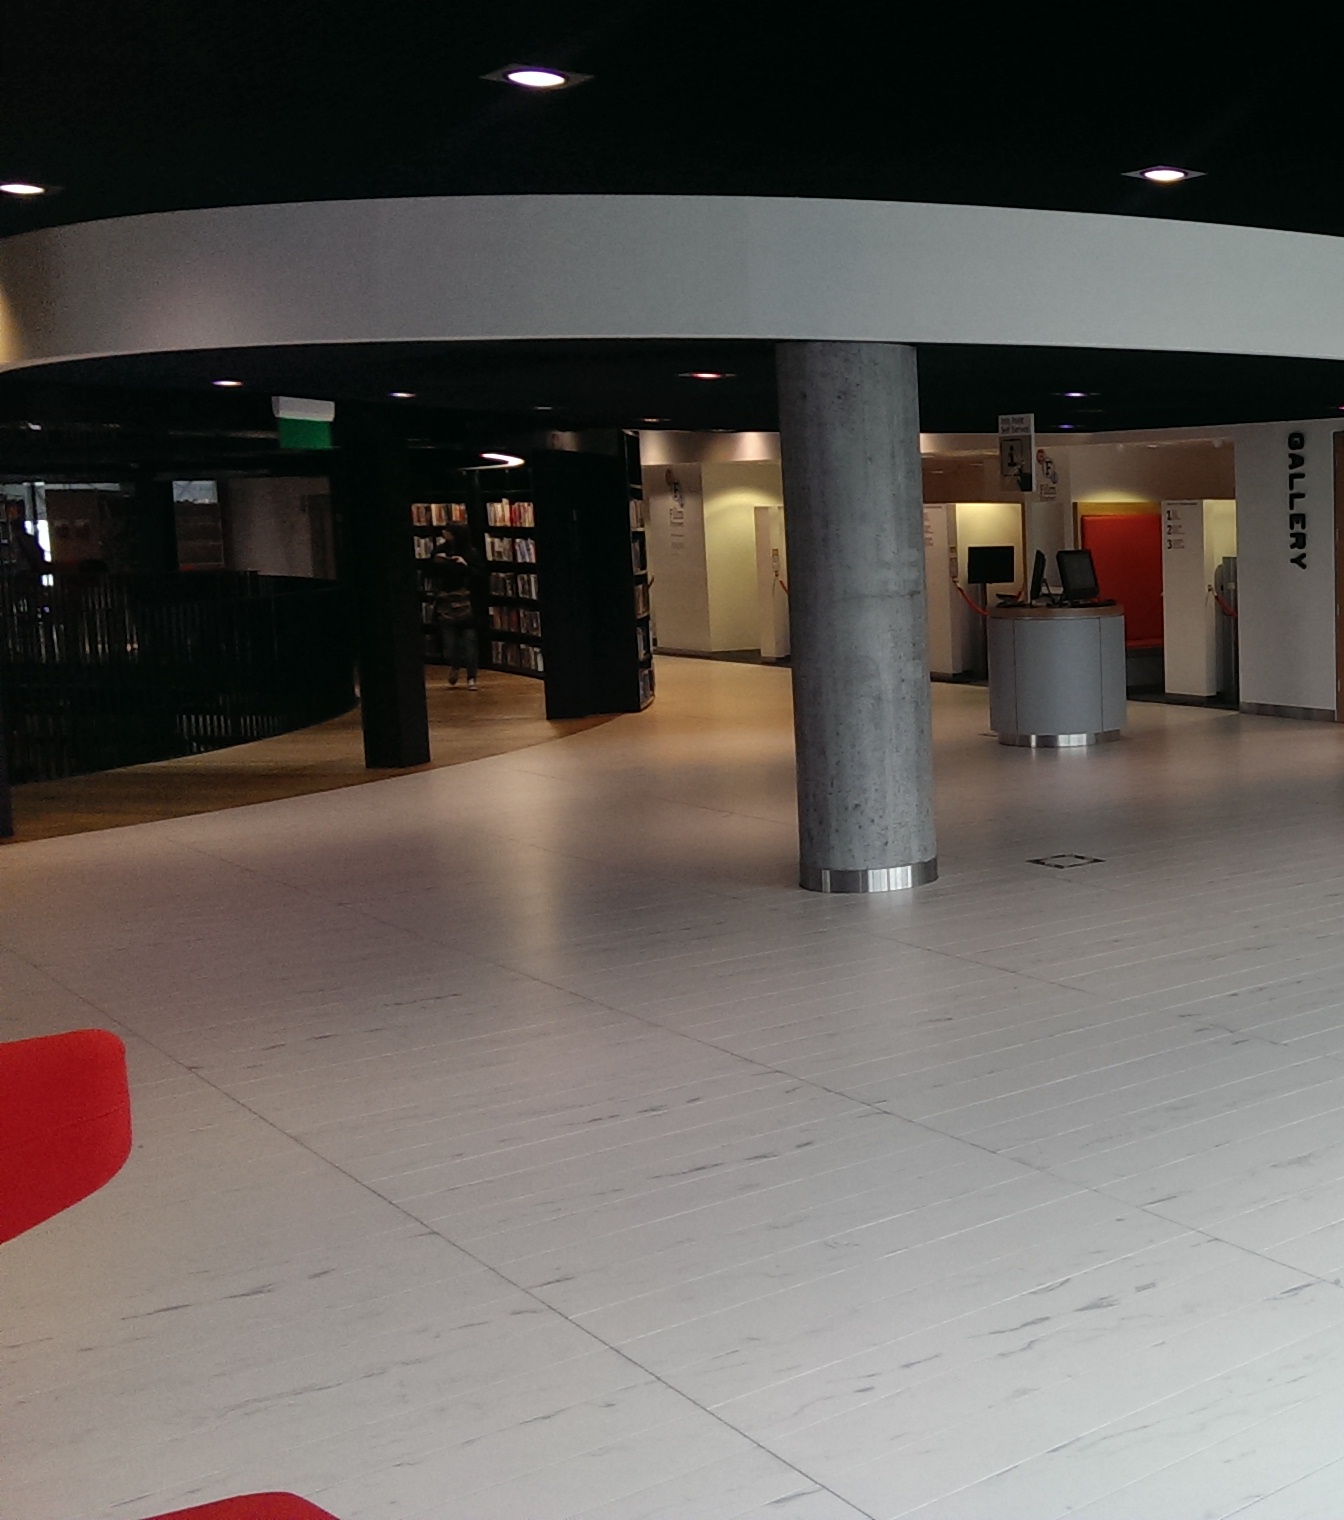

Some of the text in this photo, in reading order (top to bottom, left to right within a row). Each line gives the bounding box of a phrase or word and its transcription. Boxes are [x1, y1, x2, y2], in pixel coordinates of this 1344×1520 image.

[1287, 432, 1307, 570] GALLERY
[1166, 510, 1171, 521] 1
[1166, 525, 1172, 535] 2
[1167, 539, 1172, 549] 3
